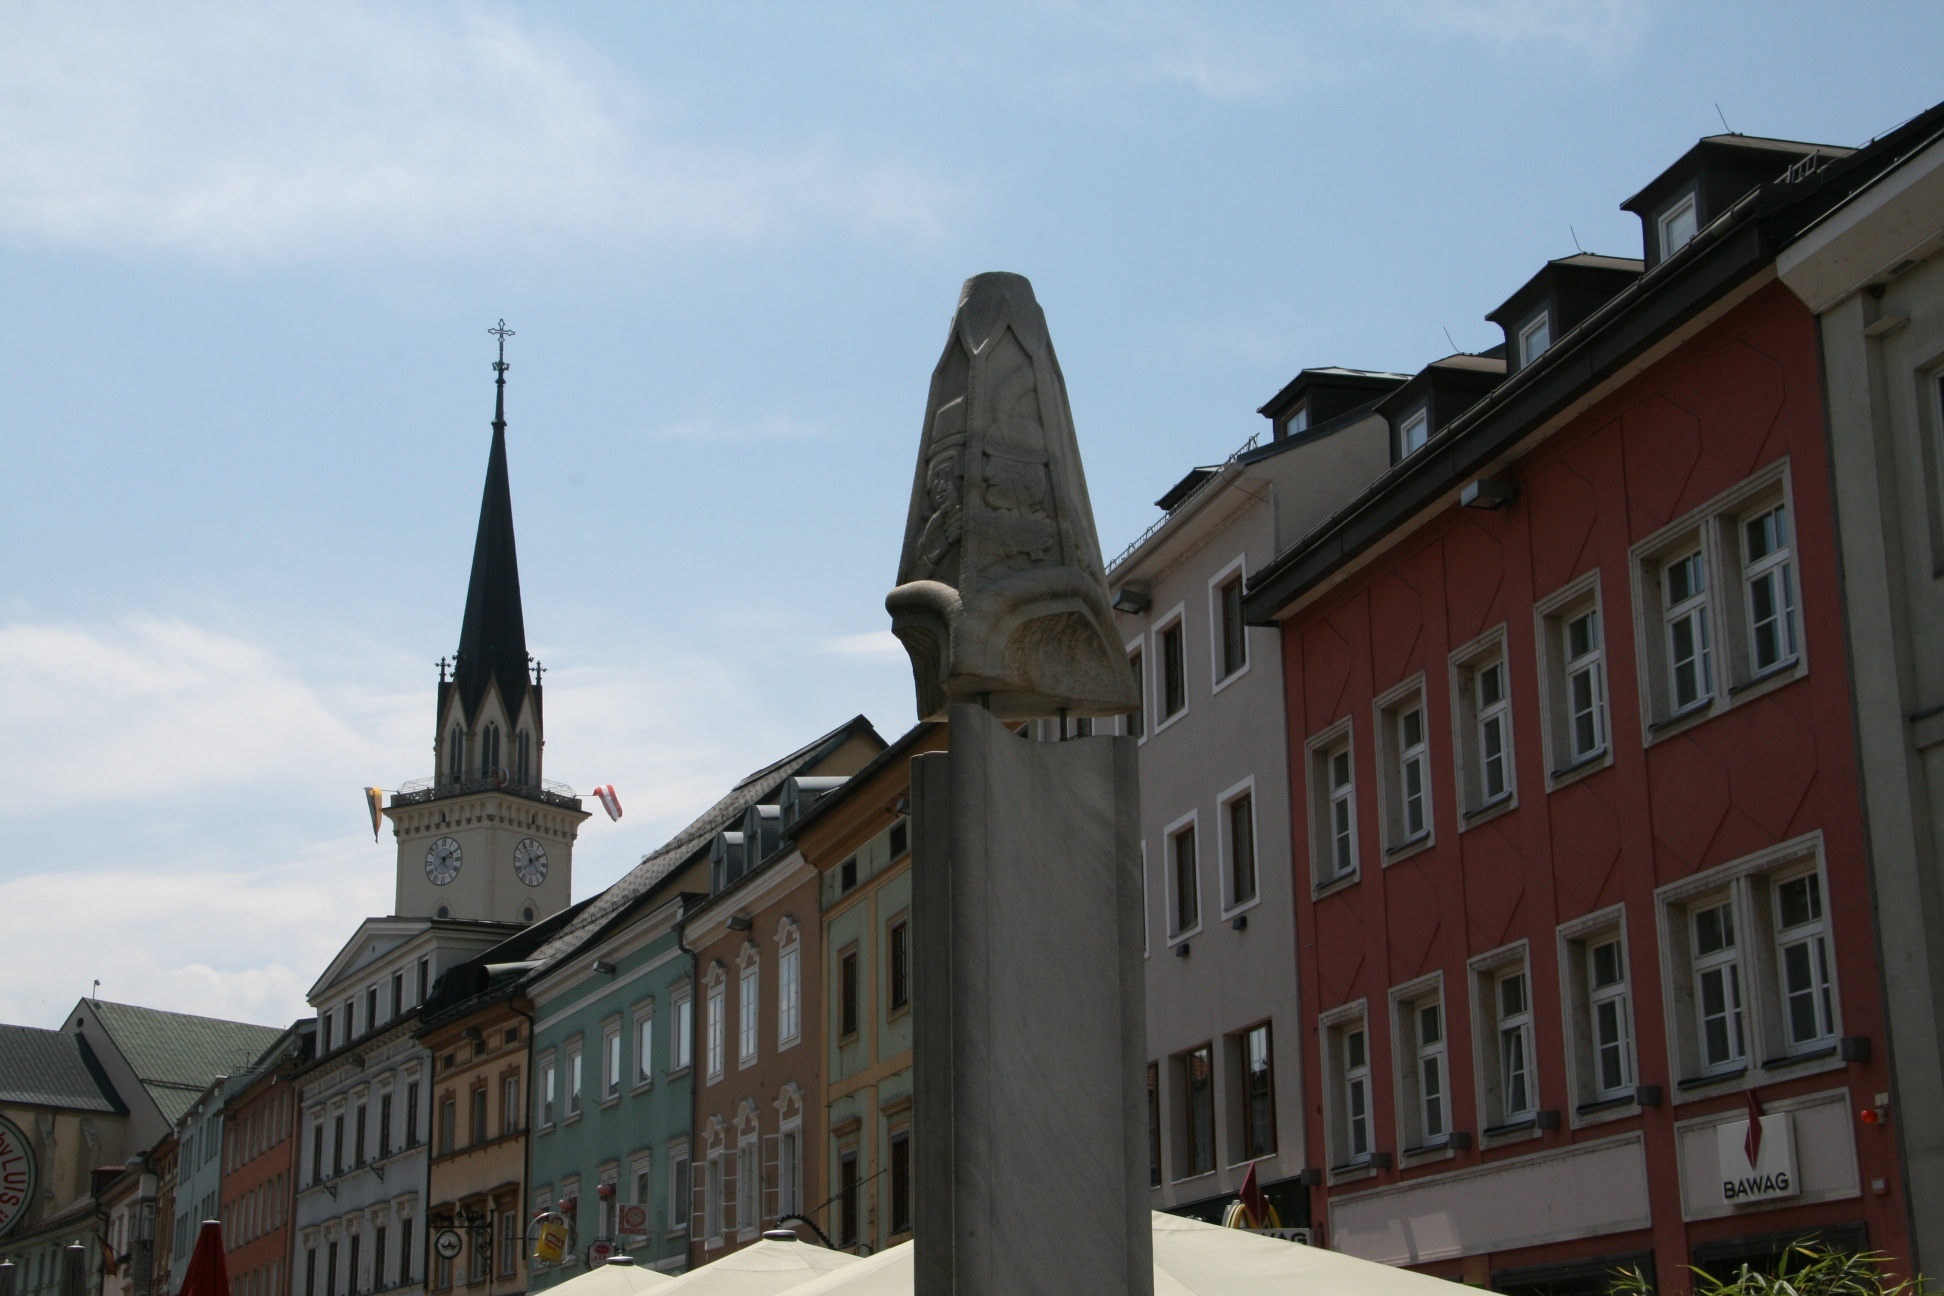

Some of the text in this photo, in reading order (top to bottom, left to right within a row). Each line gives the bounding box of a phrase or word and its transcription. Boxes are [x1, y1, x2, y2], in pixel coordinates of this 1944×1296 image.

[0, 1156, 27, 1207] LUIS
[1723, 1172, 1789, 1199] BAWAG
[546, 1233, 563, 1248] BILLA
